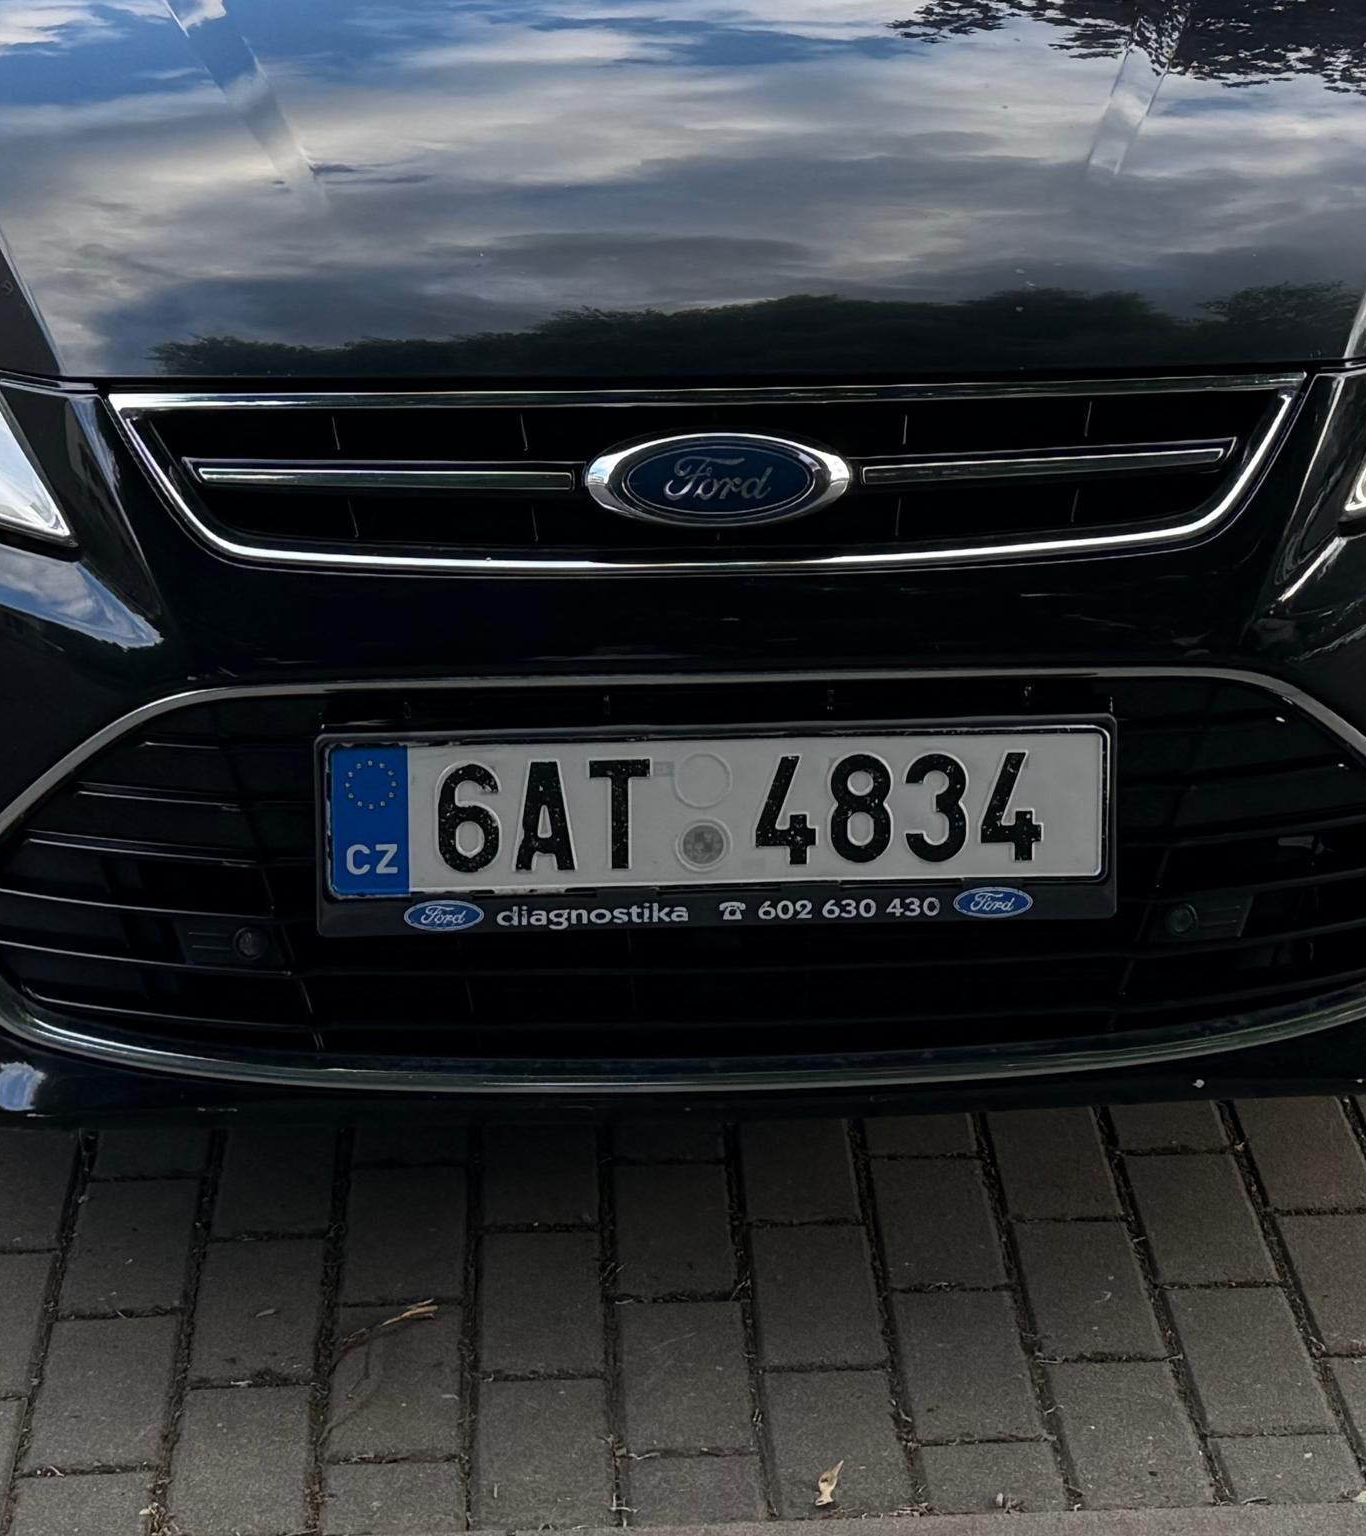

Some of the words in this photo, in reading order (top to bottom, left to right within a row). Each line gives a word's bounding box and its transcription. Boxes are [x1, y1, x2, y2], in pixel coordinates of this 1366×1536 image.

[663, 455, 774, 501] Ford
[438, 757, 651, 873] 6AT
[754, 750, 1043, 865] 4834
[346, 843, 399, 876] CZ
[420, 904, 466, 926] Ford
[495, 902, 690, 931] diagnostika
[757, 899, 813, 921] 602
[821, 898, 877, 919] 630
[885, 896, 941, 917] 430
[969, 892, 1015, 913] Ford
